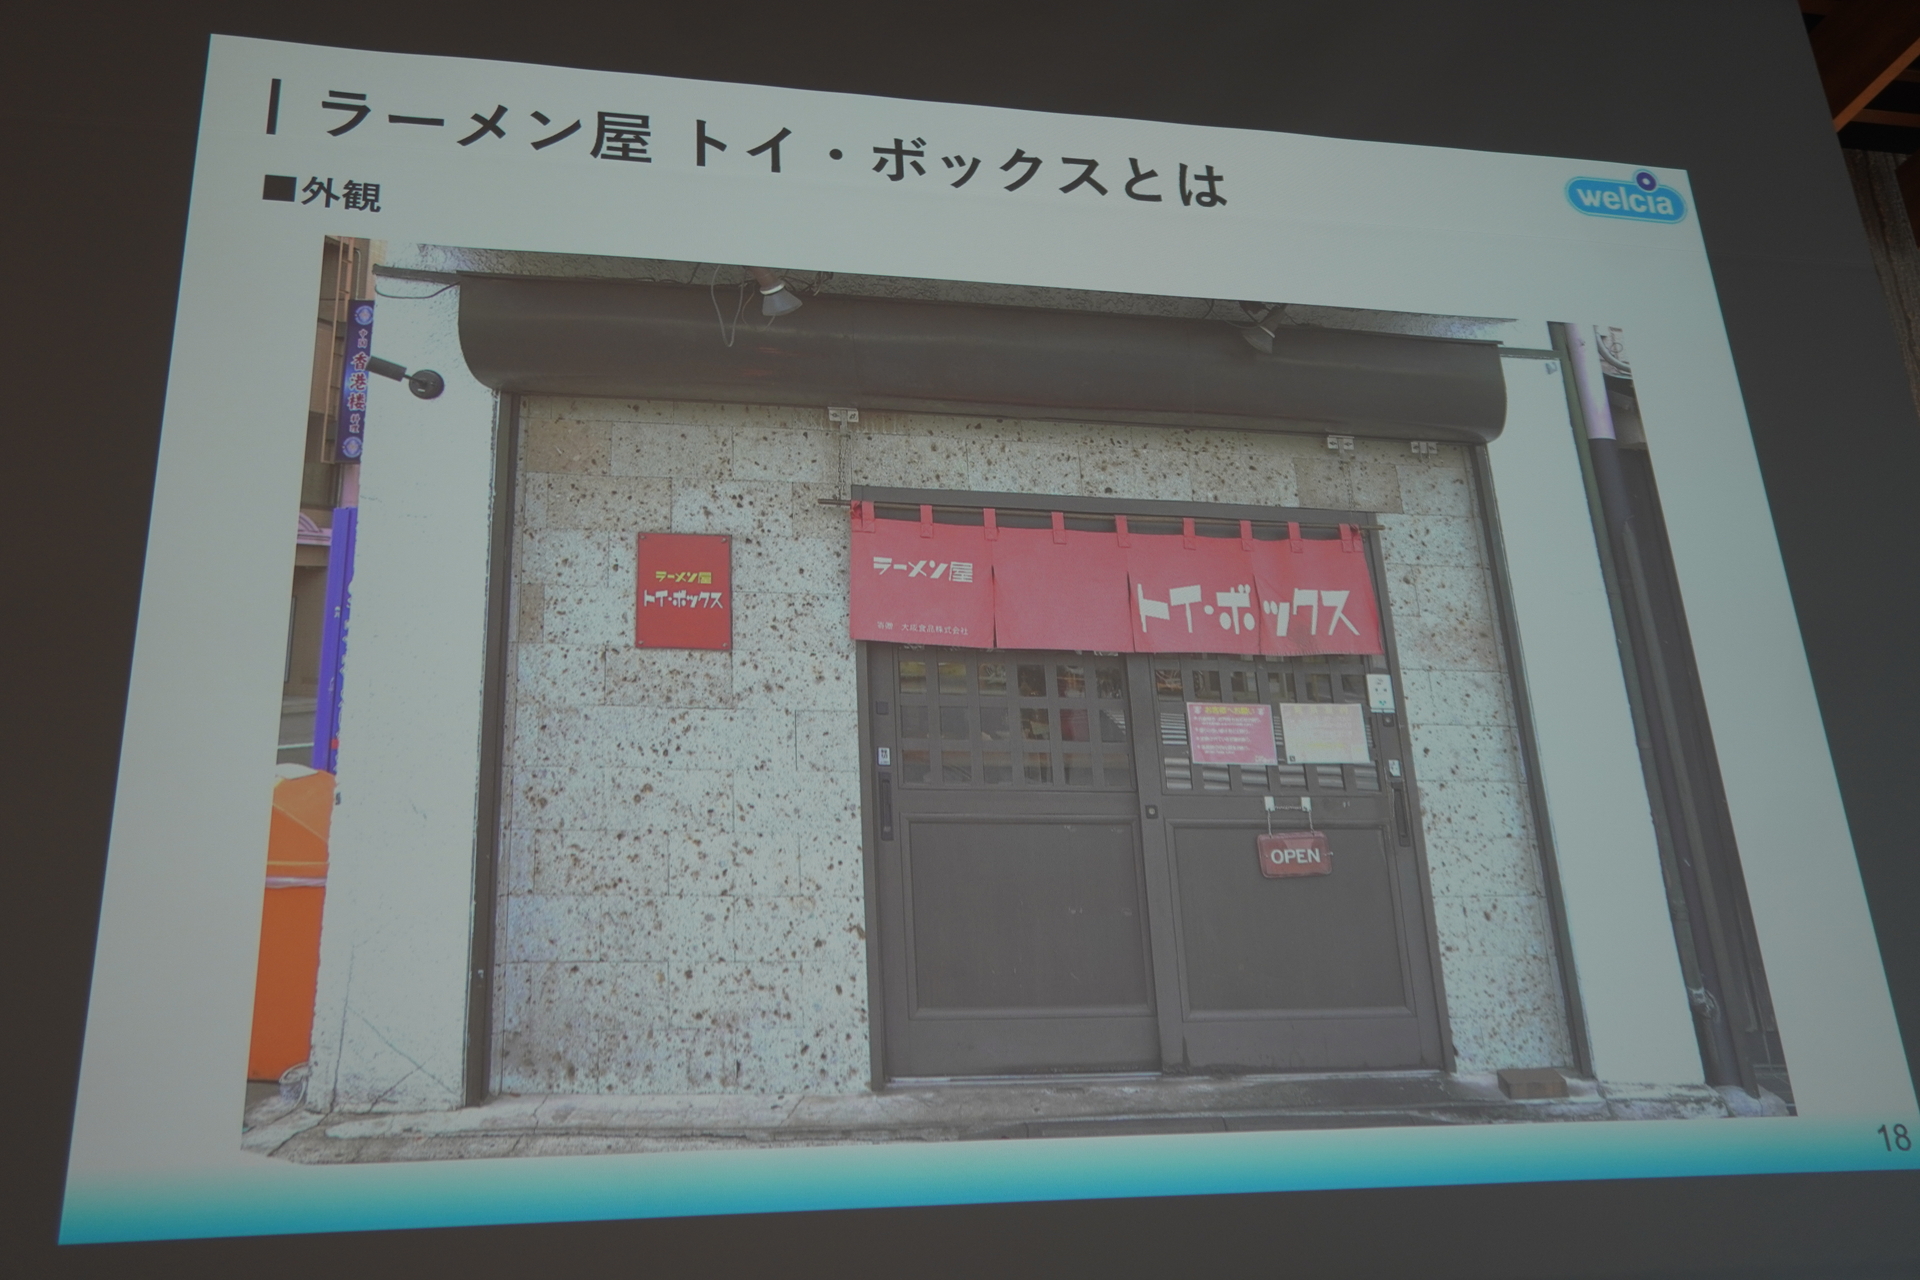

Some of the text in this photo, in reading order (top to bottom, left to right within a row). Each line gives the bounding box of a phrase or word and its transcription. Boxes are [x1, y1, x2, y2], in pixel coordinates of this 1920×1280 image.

[321, 89, 1228, 208] ラーメン屋 トイ・ボックスとは
[301, 175, 382, 213] 外観
[1576, 172, 1674, 216] welcia
[655, 571, 712, 584] ラーメン屋
[873, 556, 974, 583] ラーメン屋
[643, 589, 723, 609] トイ・ボックス
[1137, 583, 1360, 637] トイ・ボックス
[1271, 848, 1321, 864] OPEN
[1877, 1123, 1912, 1152] 18
